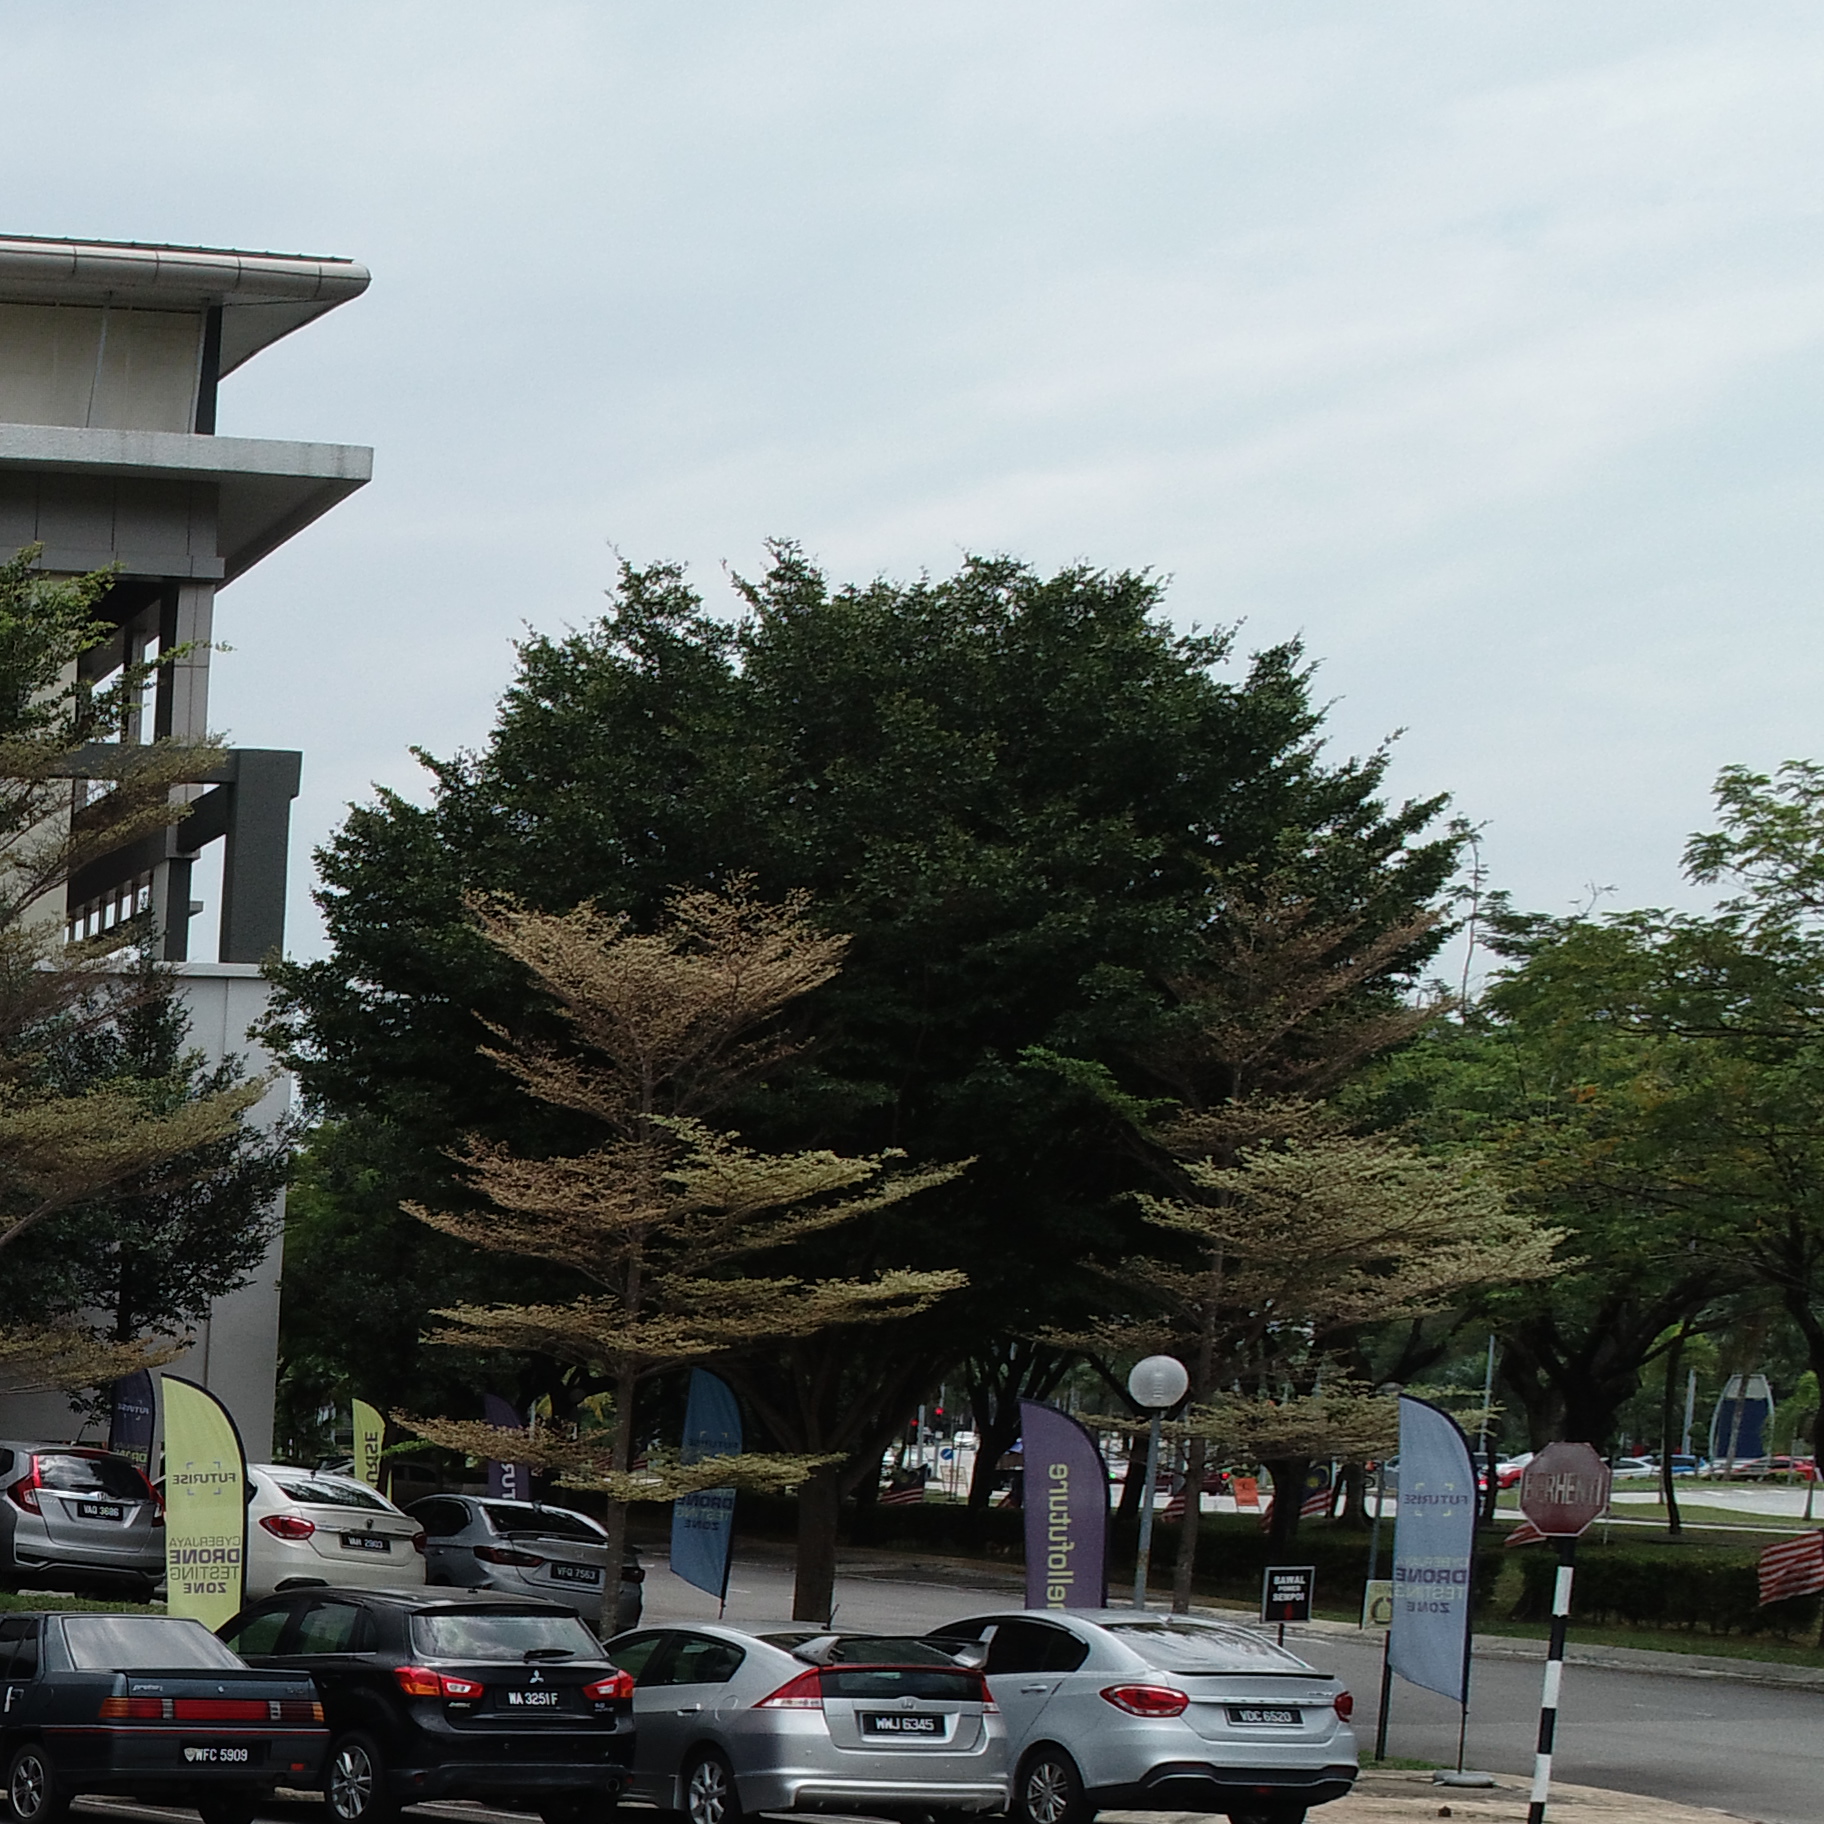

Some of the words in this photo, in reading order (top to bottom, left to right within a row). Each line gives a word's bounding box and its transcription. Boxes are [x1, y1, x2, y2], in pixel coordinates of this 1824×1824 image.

[508, 1692, 523, 1705] WA
[524, 1692, 550, 1705] 3251
[551, 1693, 559, 1705] F
[1239, 1710, 1262, 1721] VDC
[1263, 1711, 1292, 1722] 6520
[902, 1718, 935, 1731] 6345
[220, 1749, 248, 1761] 5909
